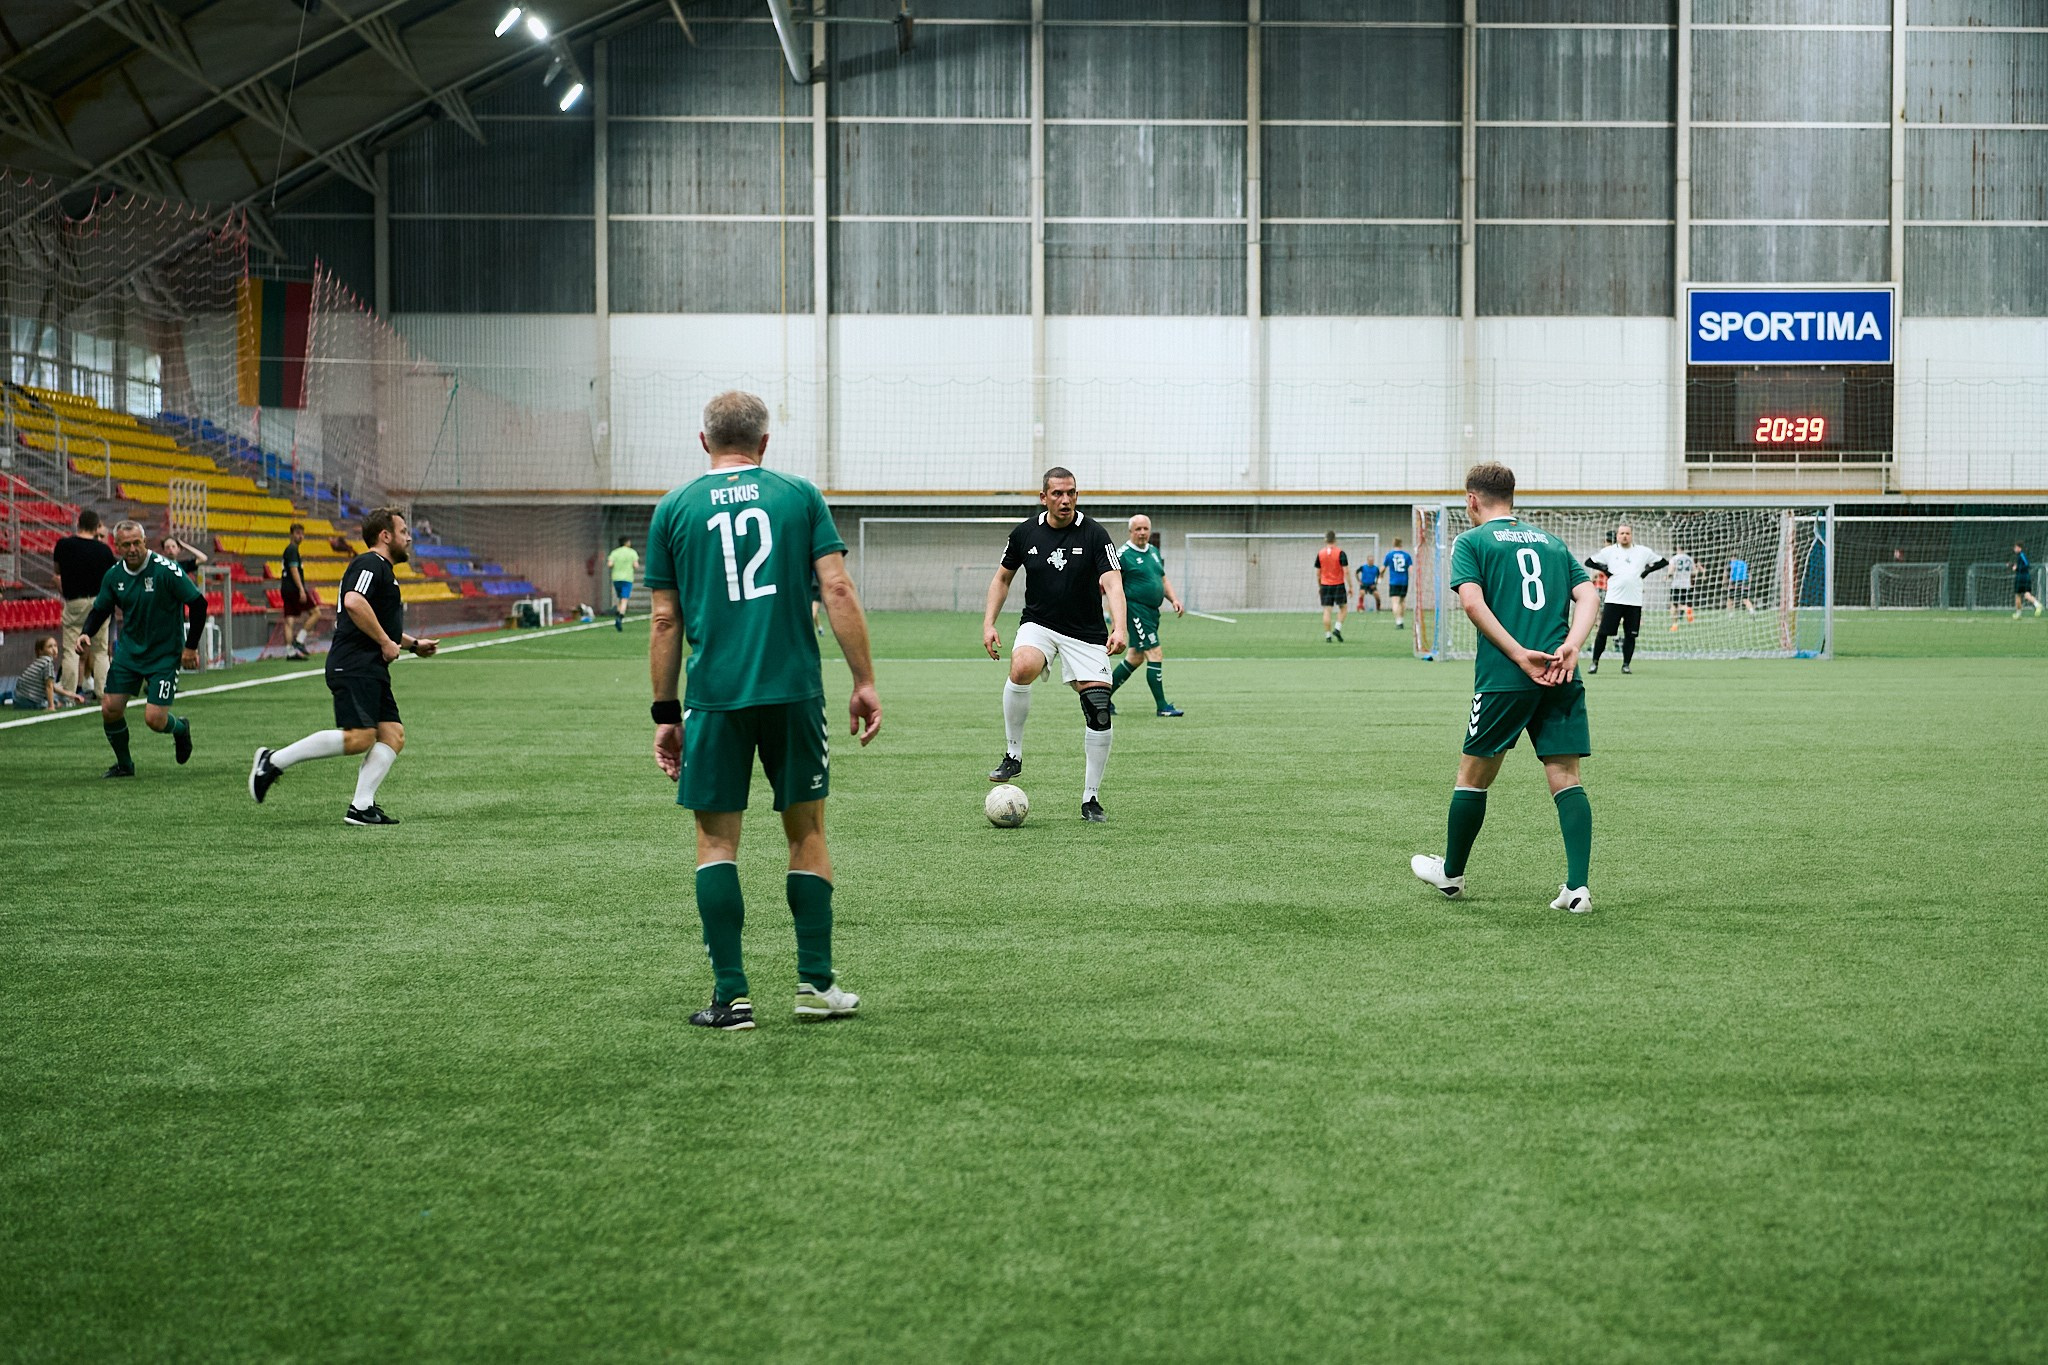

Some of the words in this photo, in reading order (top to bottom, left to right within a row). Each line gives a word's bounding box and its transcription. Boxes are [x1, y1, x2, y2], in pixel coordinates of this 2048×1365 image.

[1698, 311, 1882, 341] SPORTIMA
[1755, 417, 1825, 442] 20:39
[710, 483, 760, 506] PETKUS
[707, 507, 777, 602] 12
[1392, 557, 1406, 573] 12
[1516, 548, 1546, 611] 8
[158, 679, 171, 700] 13
